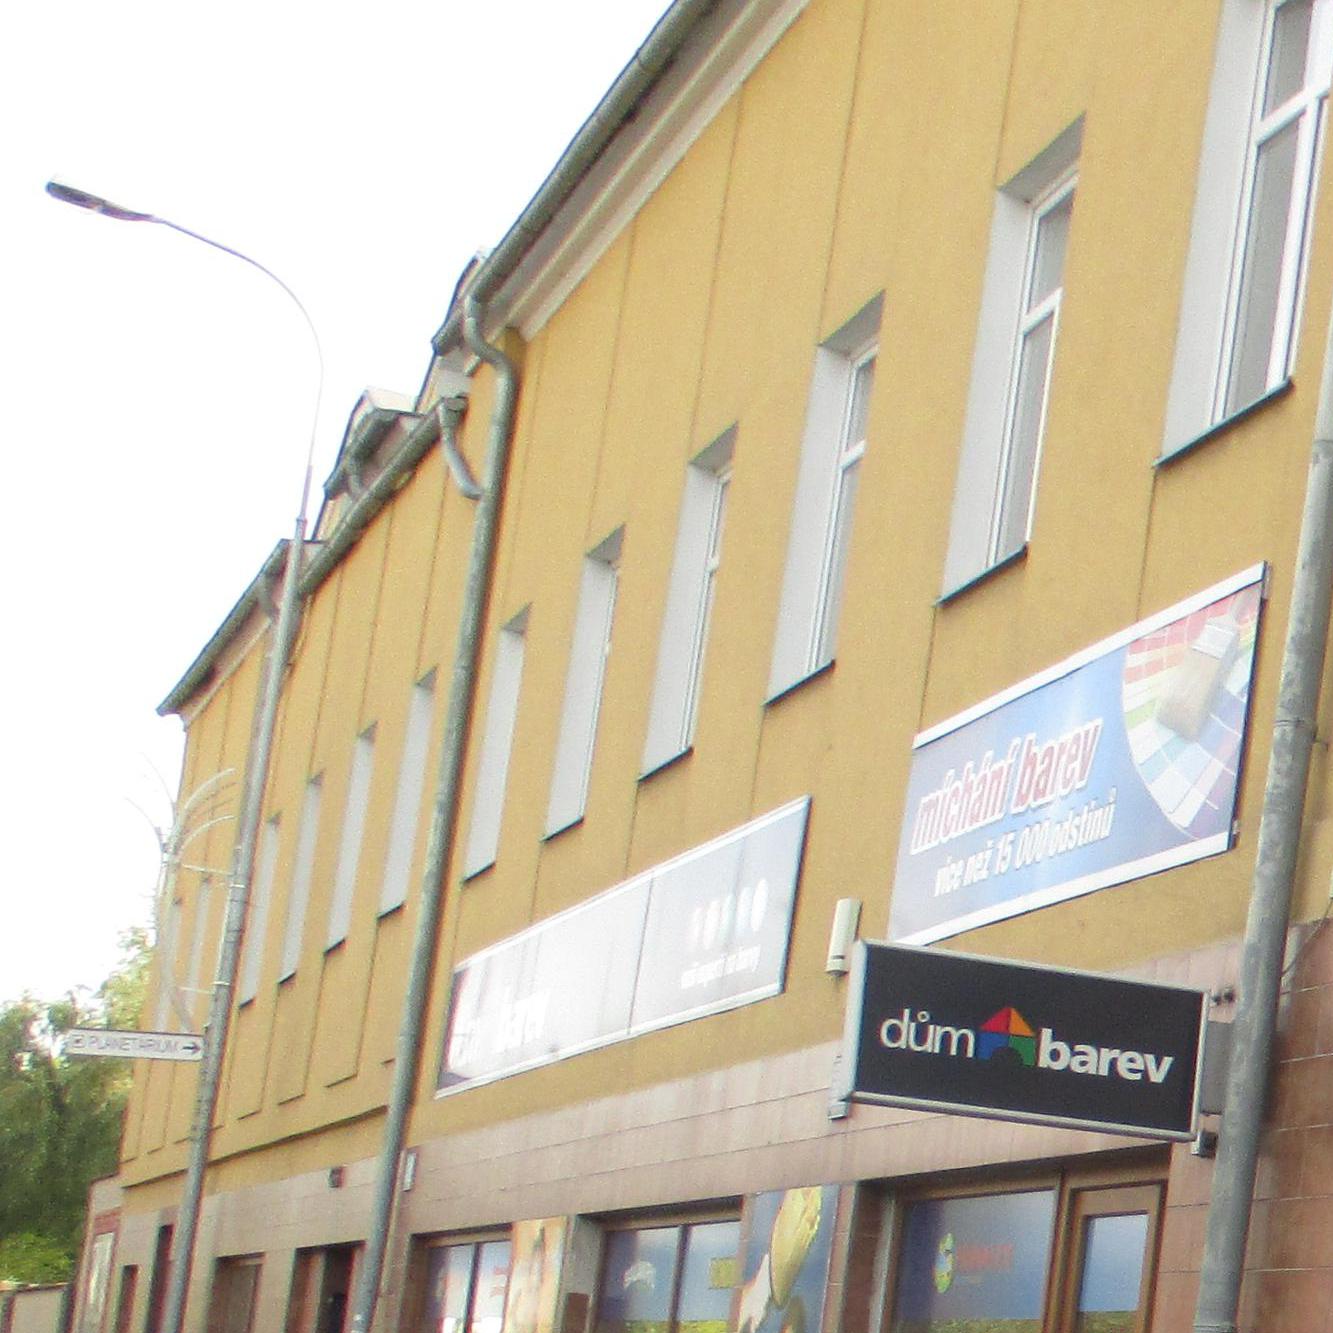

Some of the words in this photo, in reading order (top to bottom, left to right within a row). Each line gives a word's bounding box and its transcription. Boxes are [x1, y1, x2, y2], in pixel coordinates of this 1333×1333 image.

[1010, 716, 1104, 815] barev
[994, 831, 1016, 876] 15
[878, 1007, 977, 1060] dům
[1037, 1026, 1175, 1086] barev
